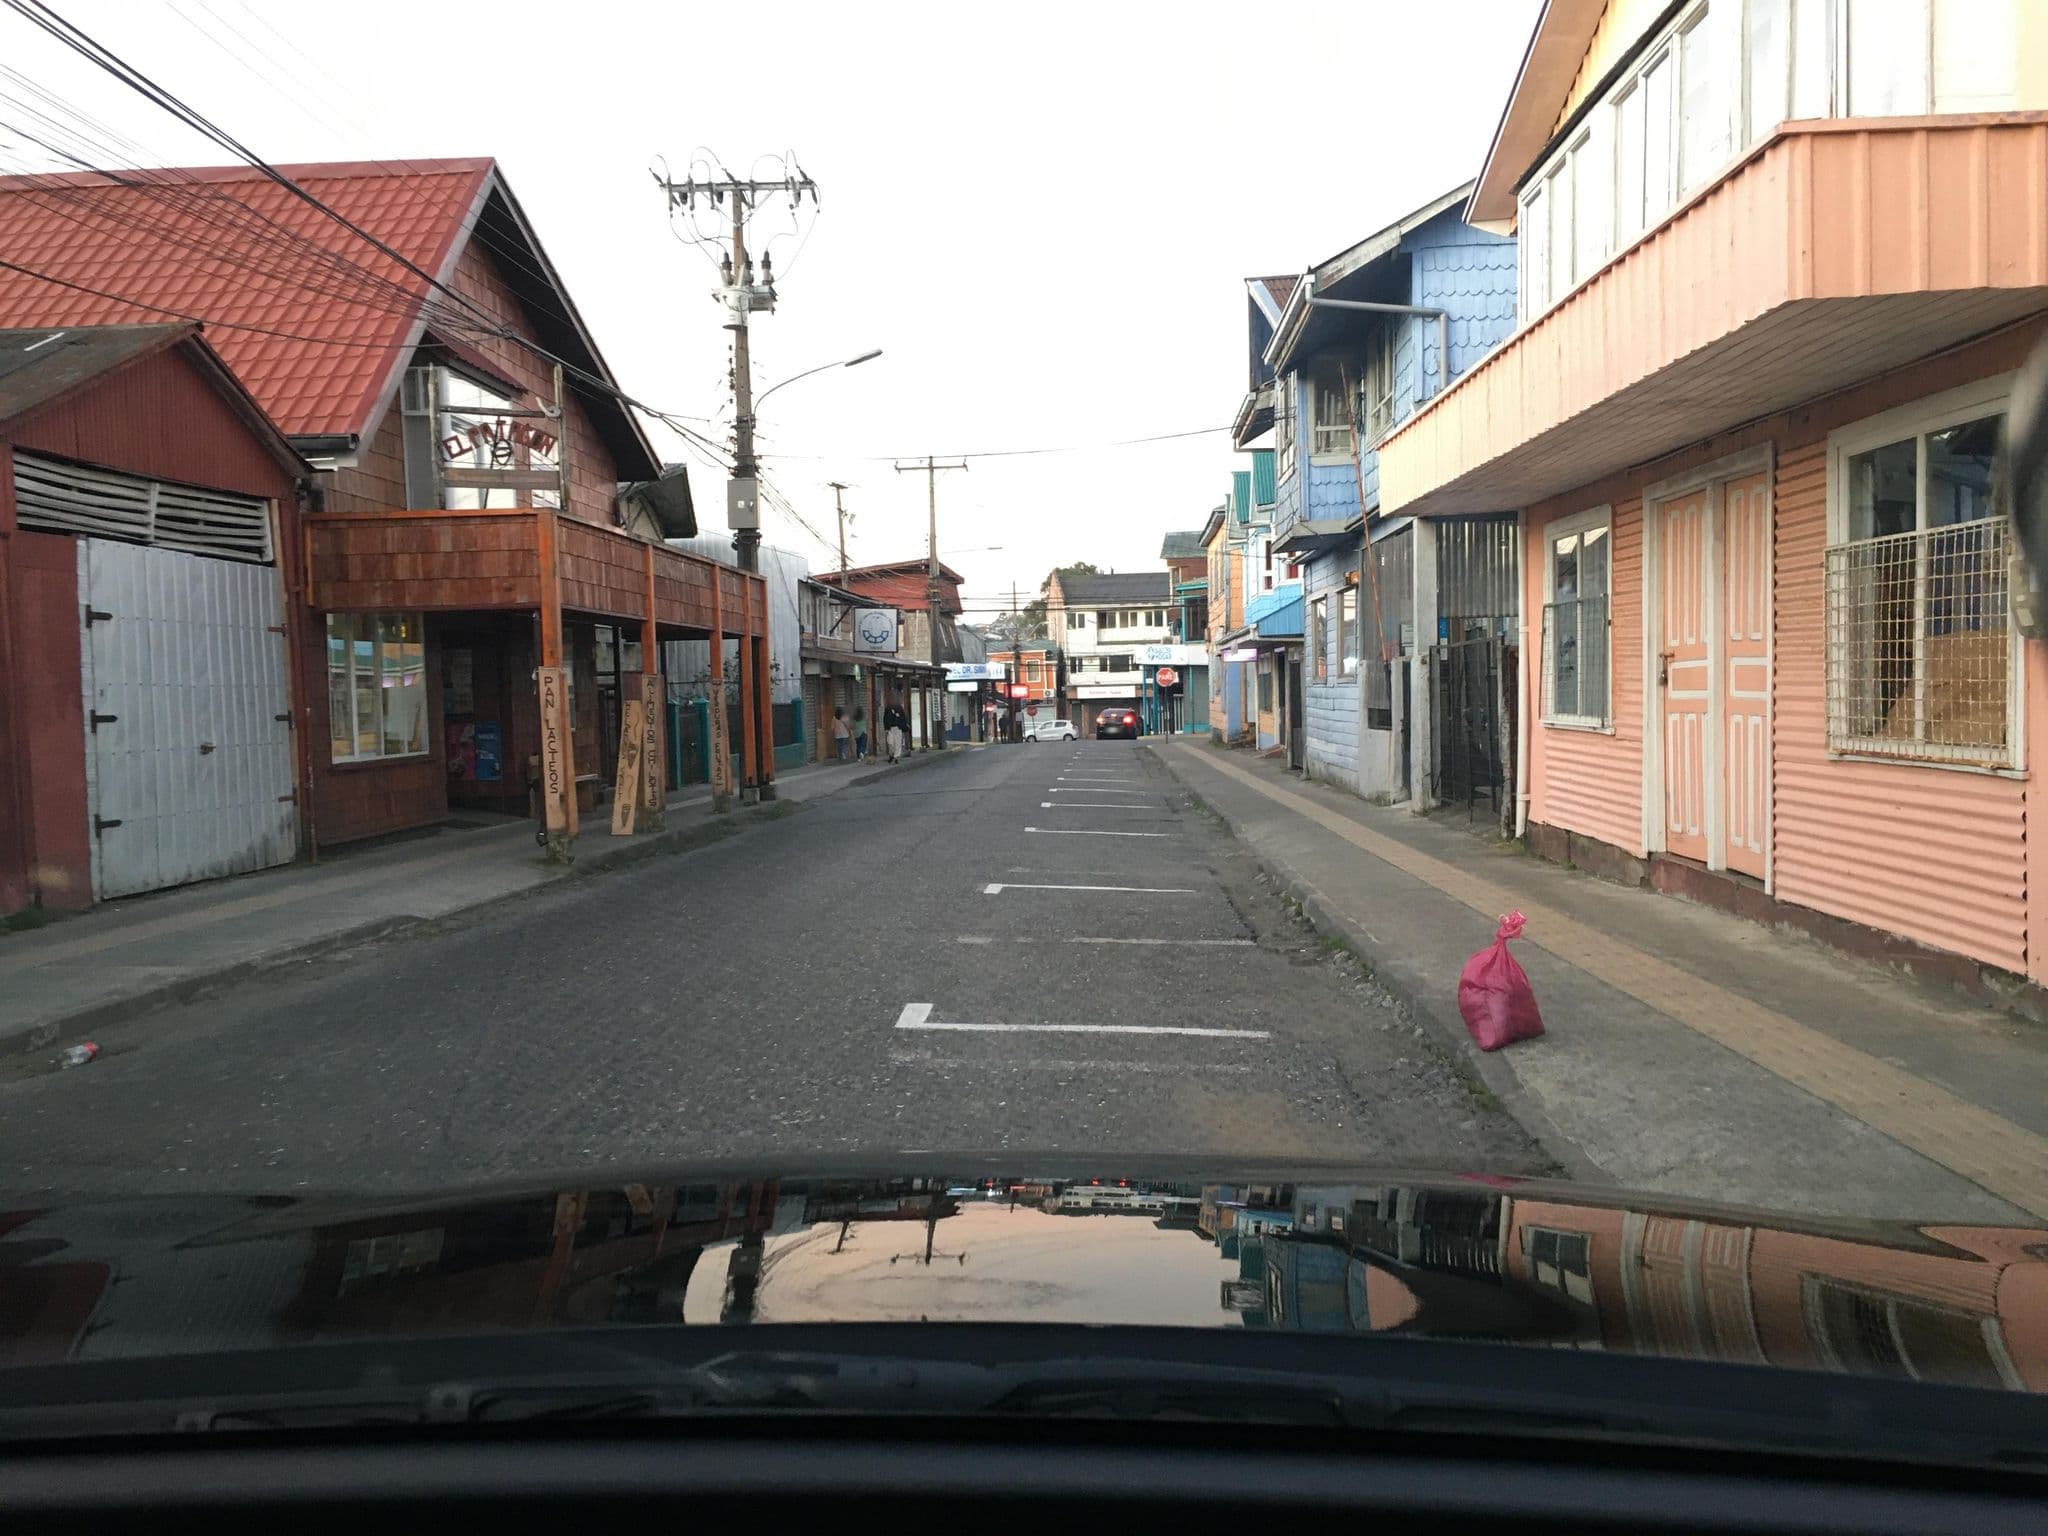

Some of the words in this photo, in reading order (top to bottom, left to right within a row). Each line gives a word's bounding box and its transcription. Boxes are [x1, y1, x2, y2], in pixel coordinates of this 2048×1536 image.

[441, 435, 474, 460] EL
[544, 676, 554, 709] PAN
[545, 719, 558, 794] LACTEOS
